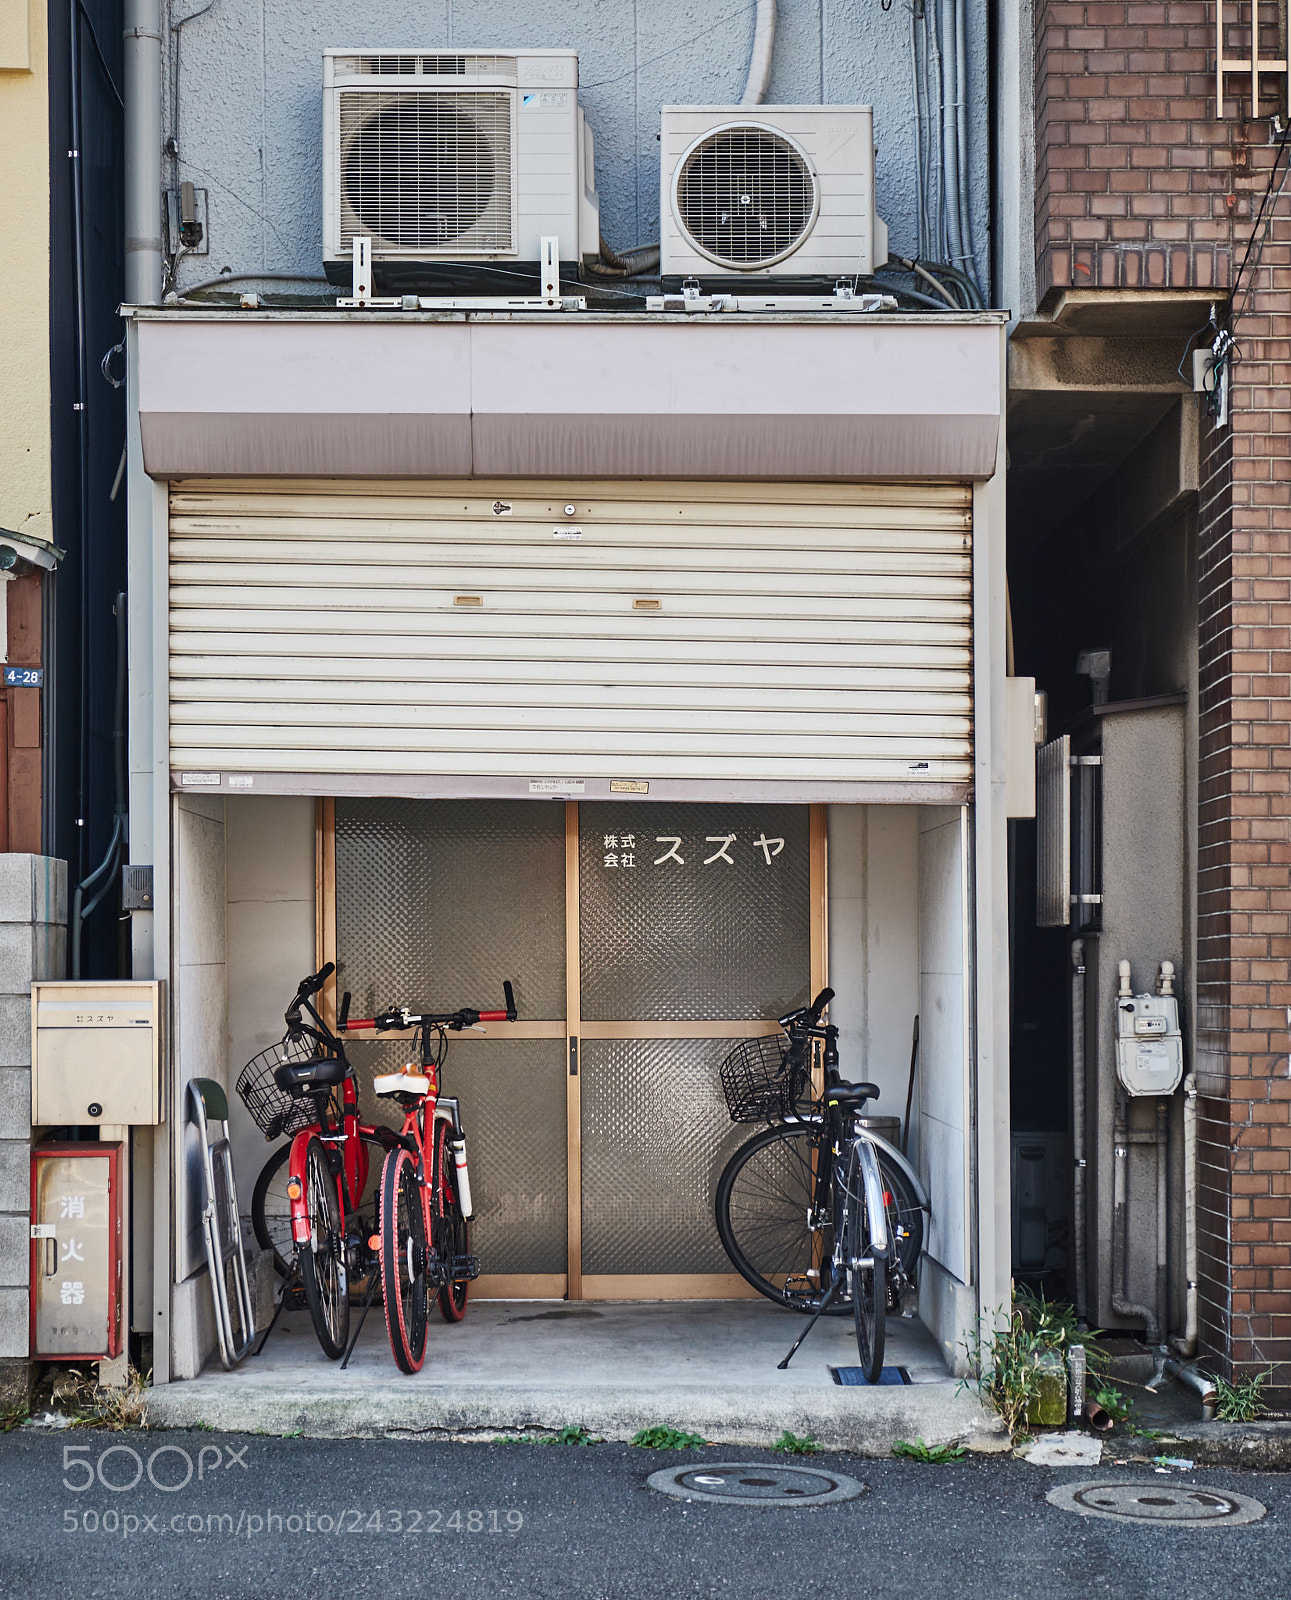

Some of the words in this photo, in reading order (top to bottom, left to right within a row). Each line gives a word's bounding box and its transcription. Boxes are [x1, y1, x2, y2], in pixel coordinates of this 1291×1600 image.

[8, 670, 38, 683] 4-28
[603, 834, 636, 849] 株式
[653, 833, 785, 865] スズヤ
[603, 852, 636, 868] 会社
[60, 1195, 85, 1305] 消火器
